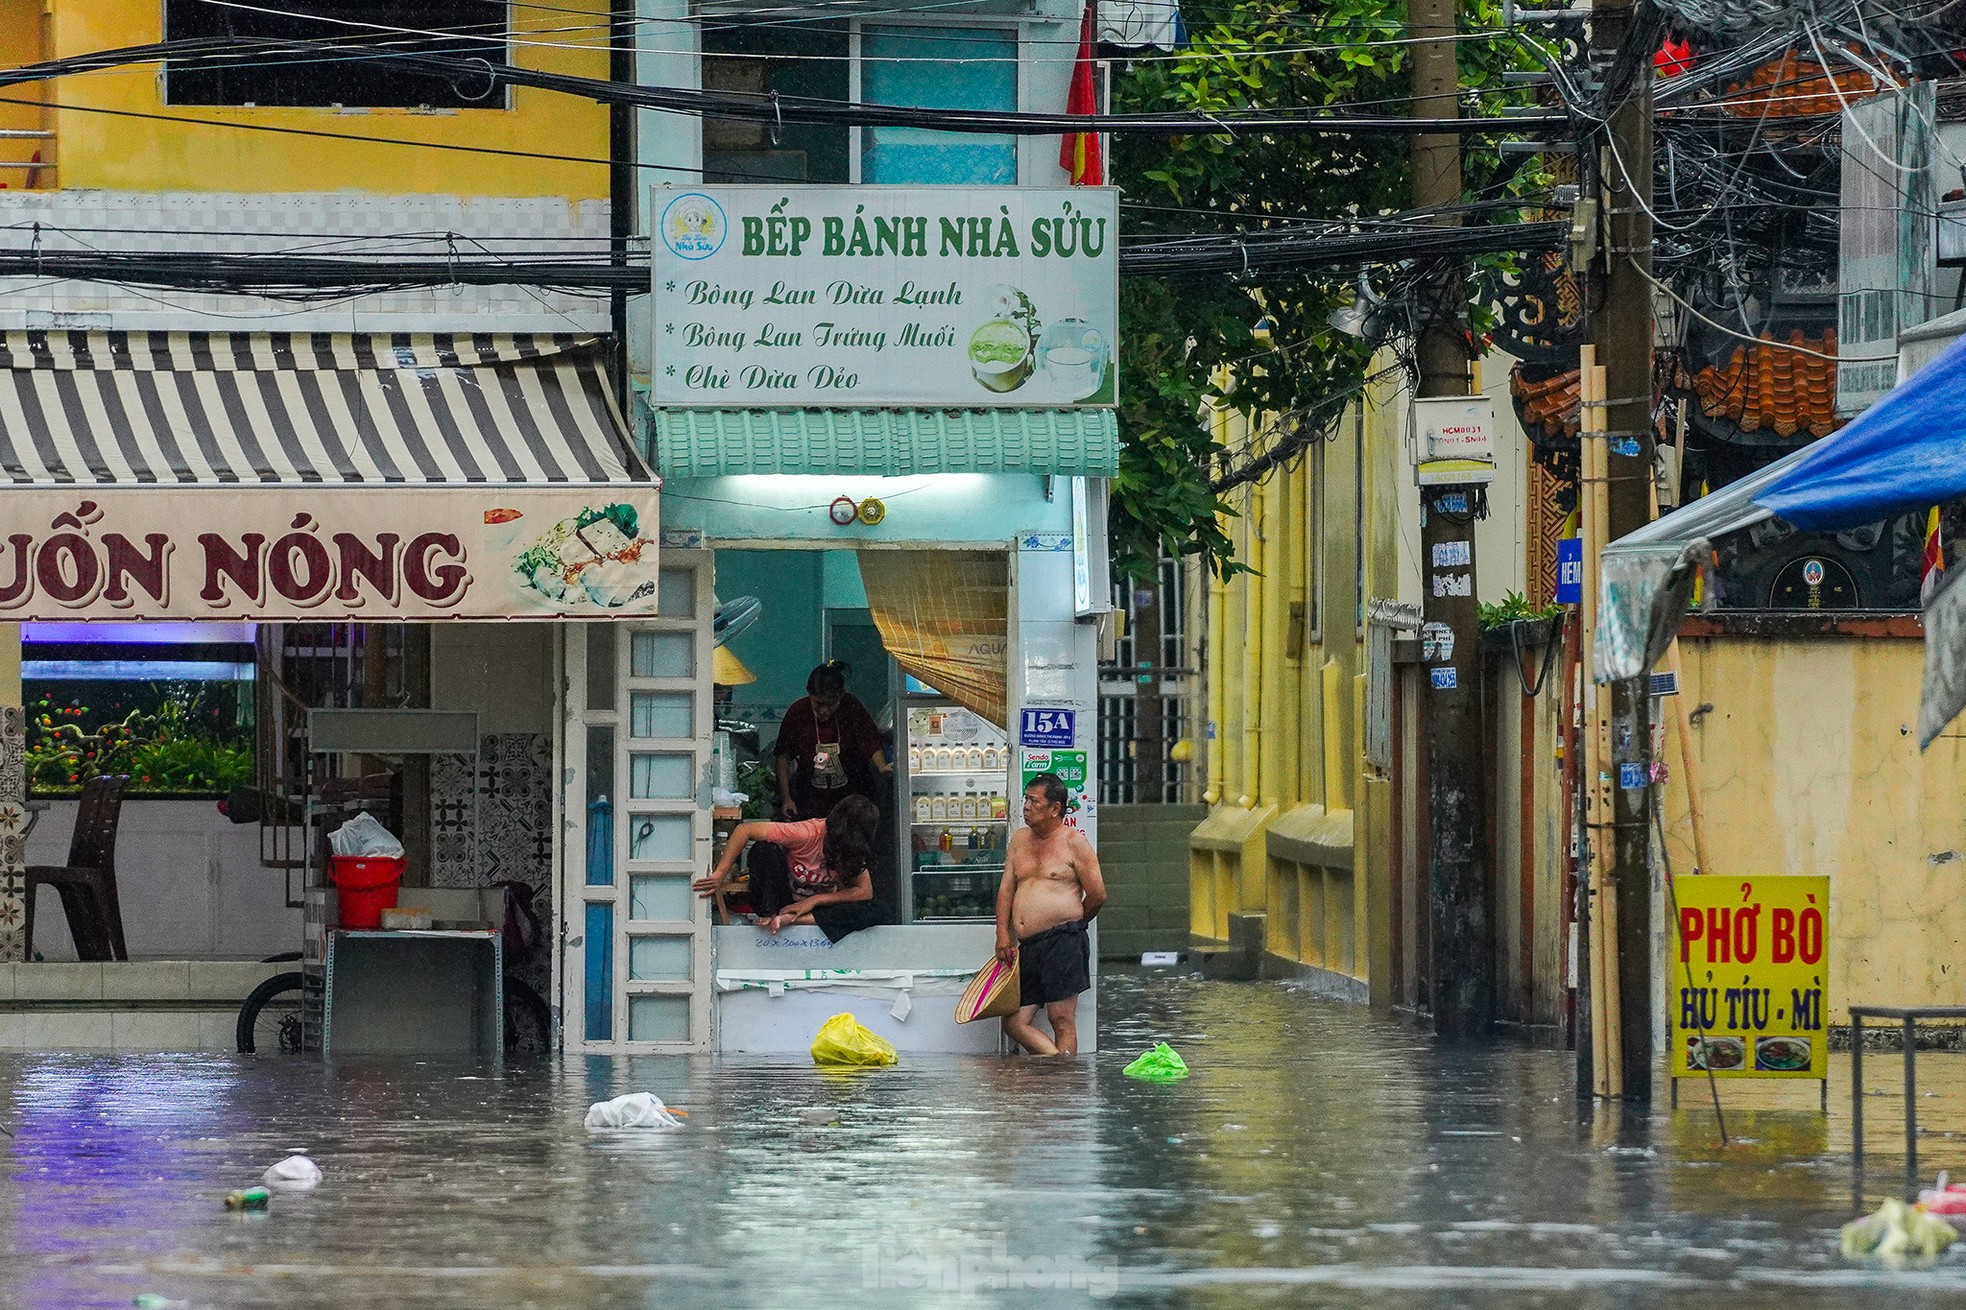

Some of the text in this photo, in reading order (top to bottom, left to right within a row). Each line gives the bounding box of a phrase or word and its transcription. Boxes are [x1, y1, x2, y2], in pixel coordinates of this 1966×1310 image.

[742, 197, 1106, 258] BẾP BÁNH NHÀ SỬU
[685, 280, 963, 310] Bông Lan Dừa Lạnh
[682, 322, 957, 352] Bông Lan Trứng Muối
[685, 364, 861, 389] Chè Dừa Dẻo
[197, 511, 474, 609] NÓNG
[1026, 712, 1069, 733] 15A
[1680, 882, 1823, 965] PHỞ BÒ
[1680, 970, 1718, 1030] HỦ
[1724, 974, 1770, 1030] TÍU
[1791, 975, 1822, 1030] MÌ
